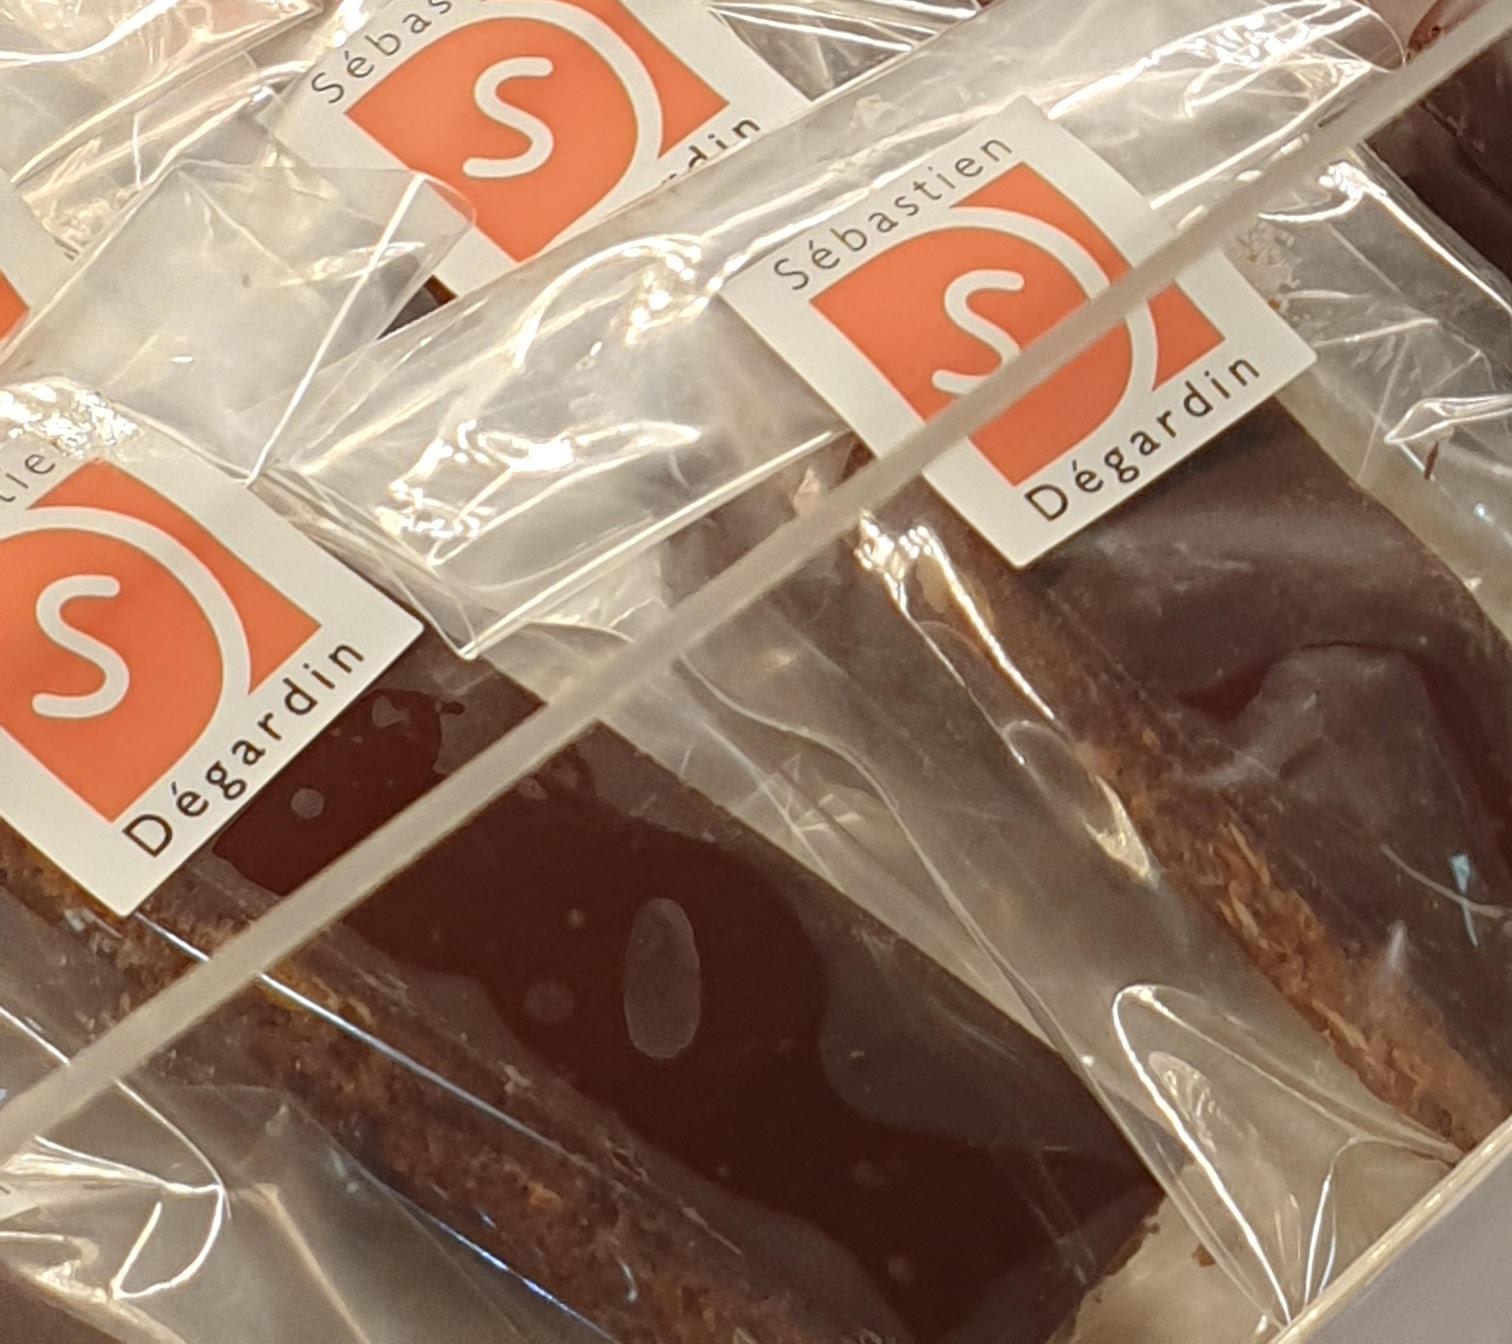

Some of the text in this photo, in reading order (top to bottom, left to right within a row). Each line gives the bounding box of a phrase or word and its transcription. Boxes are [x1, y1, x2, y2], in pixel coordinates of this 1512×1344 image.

[772, 134, 1014, 292] Sébastien
[1023, 354, 1261, 522] Dégardin
[121, 639, 366, 858] Dégardin
